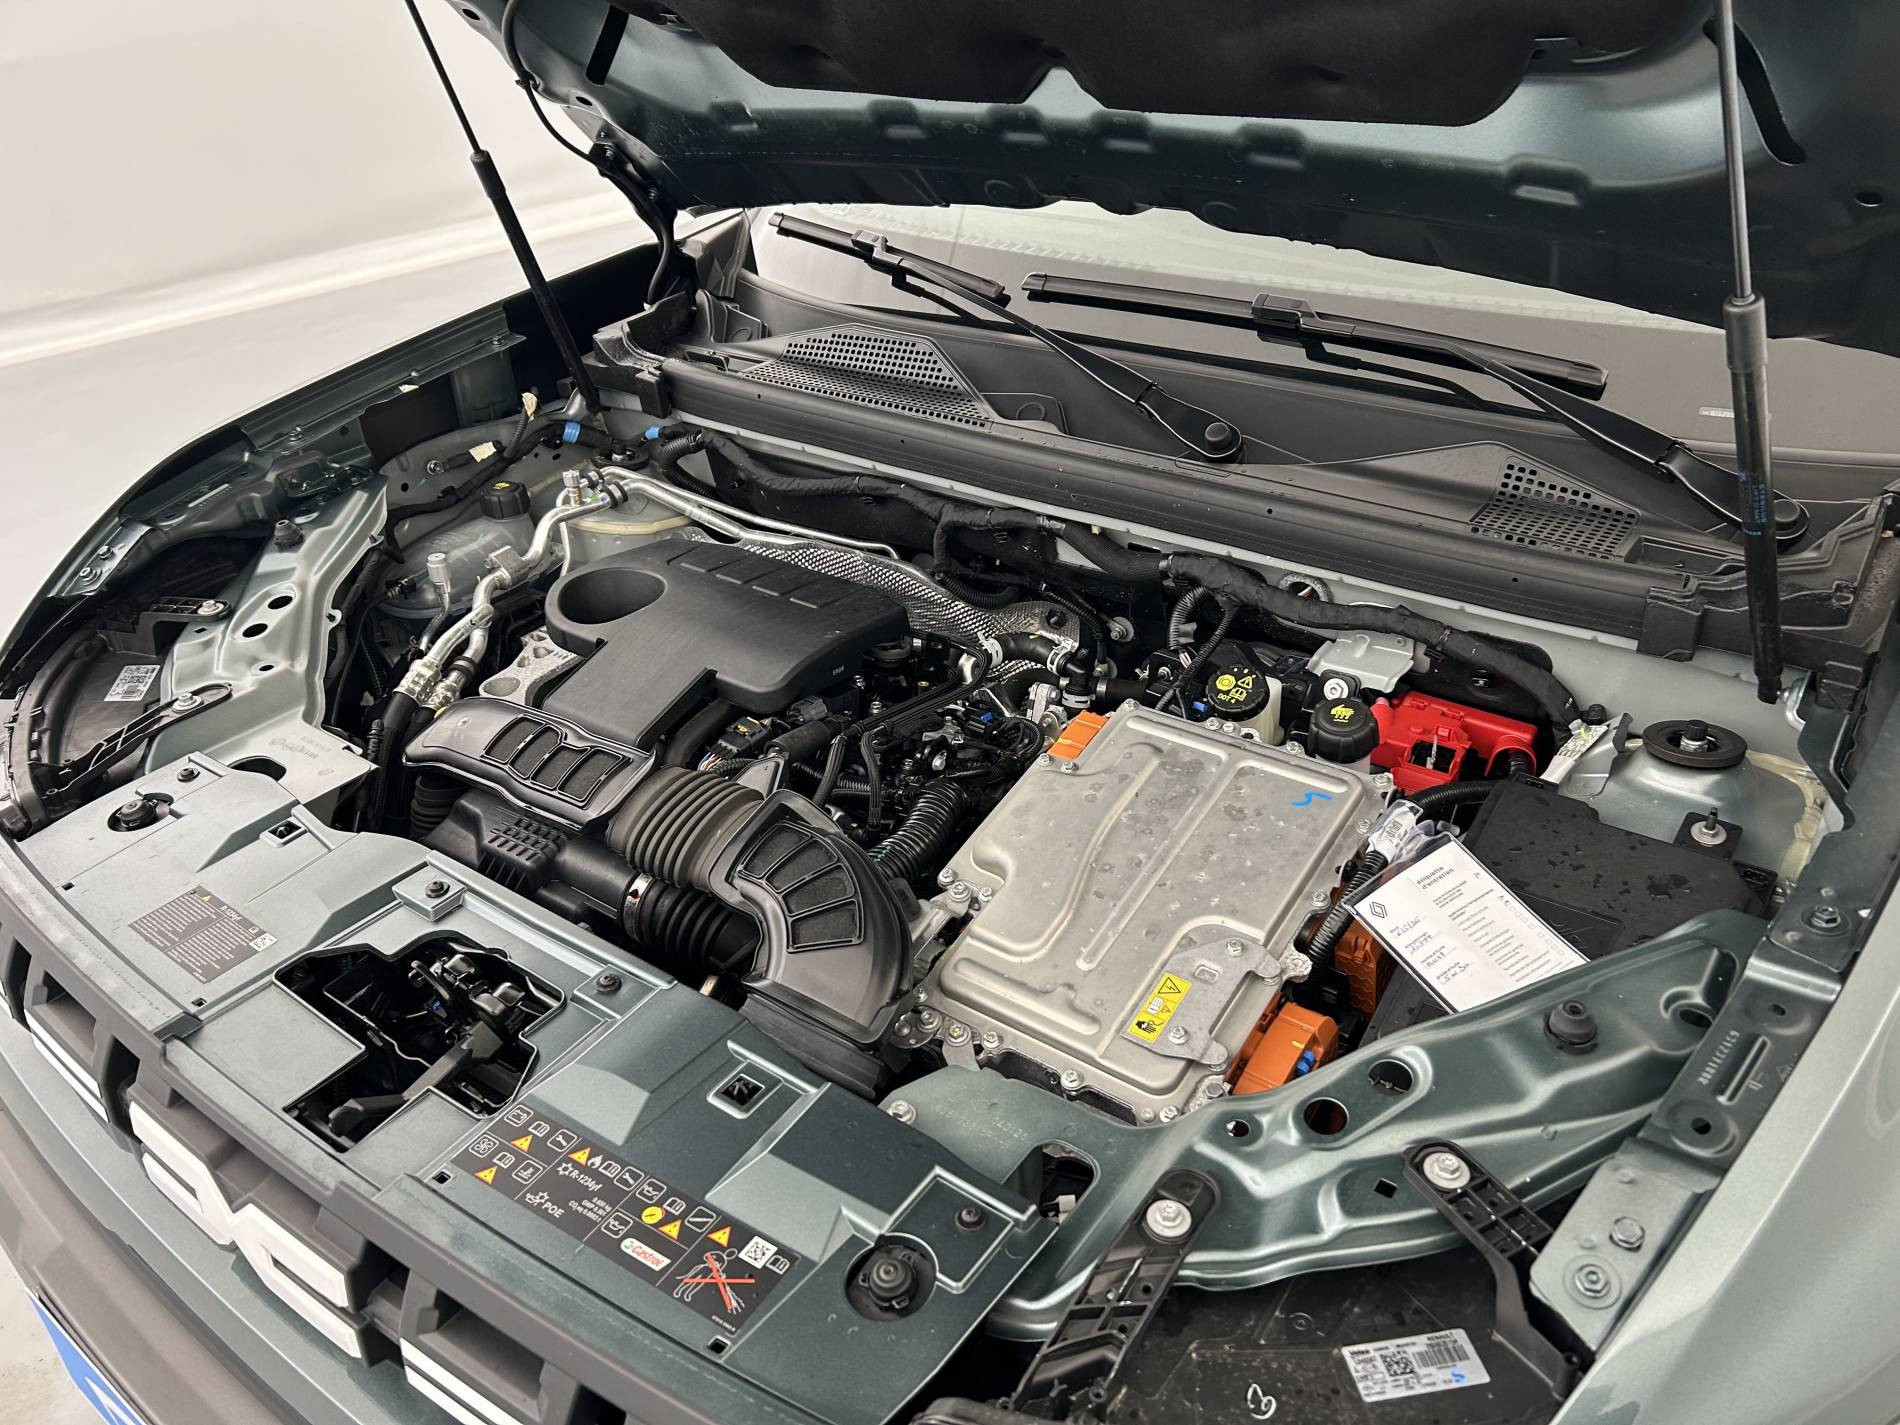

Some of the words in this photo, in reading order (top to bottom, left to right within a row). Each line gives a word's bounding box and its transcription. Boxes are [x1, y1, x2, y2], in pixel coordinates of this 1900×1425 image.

[1217, 692, 1231, 702] DOT
[569, 1169, 603, 1192] R-1234yf
[541, 1201, 565, 1219] POE
[631, 1245, 664, 1268] Castrol
